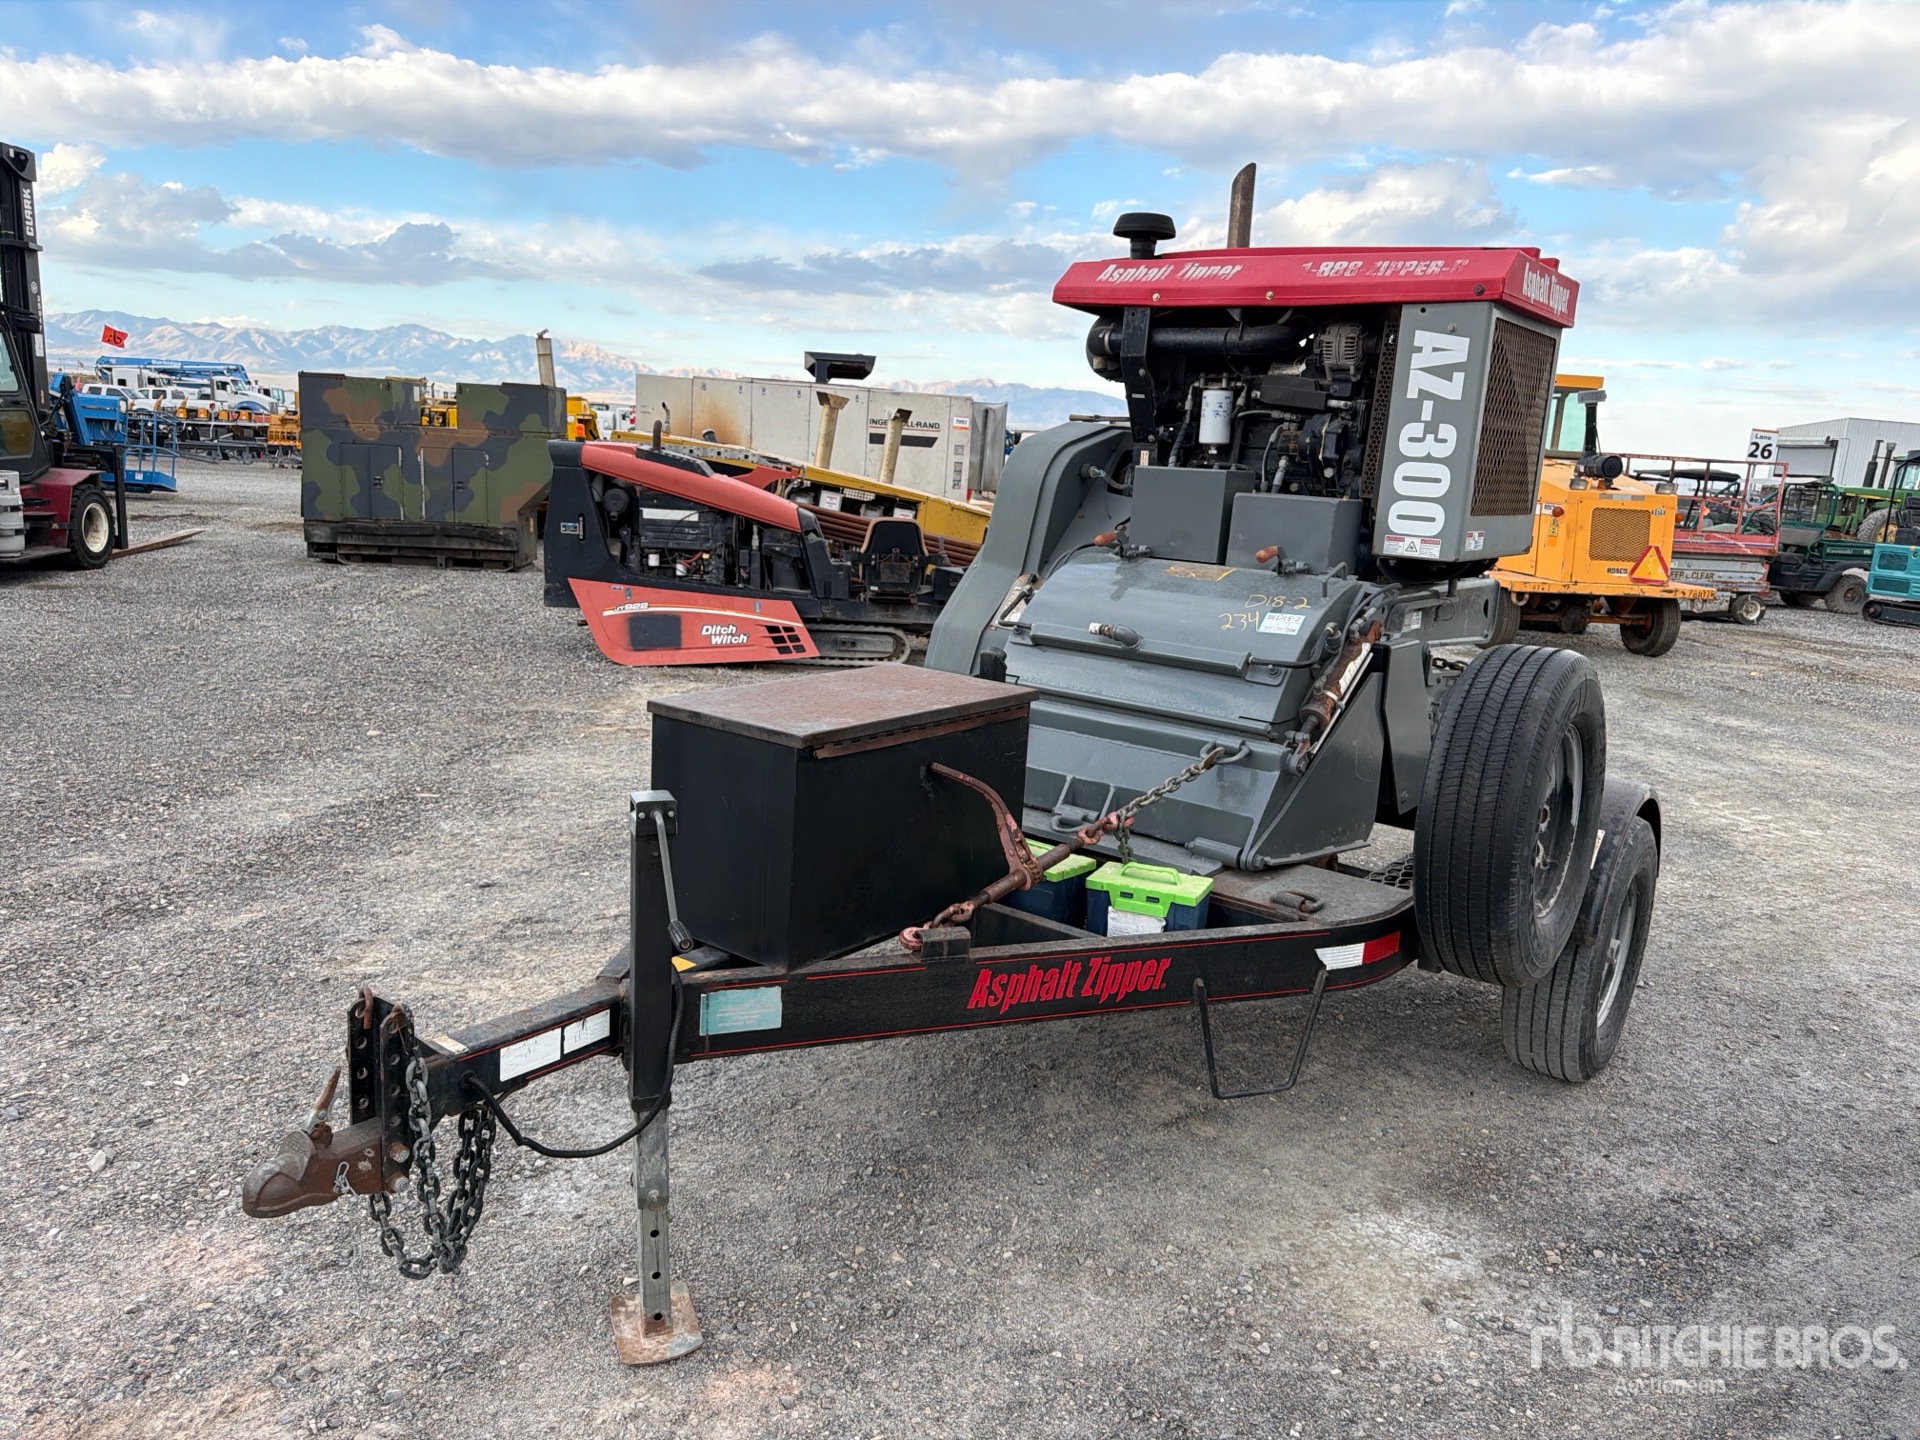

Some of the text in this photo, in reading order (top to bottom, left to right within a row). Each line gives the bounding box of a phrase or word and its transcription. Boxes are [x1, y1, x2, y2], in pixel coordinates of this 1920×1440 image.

[23, 188, 35, 237] CLARK
[1096, 264, 1175, 285] Asphalt
[1522, 261, 1570, 316] Asphalt Zipper
[1387, 329, 1470, 537] AZ-300
[1755, 433, 1772, 441] Lane
[1747, 441, 1773, 460] 26
[1691, 571, 1715, 580] CLEAR
[1244, 594, 1311, 610] D18-2
[701, 625, 737, 636] Ditch
[1218, 610, 1260, 633] 234
[711, 634, 748, 646] Witch
[966, 956, 1173, 1015] Asphalt Zipper
